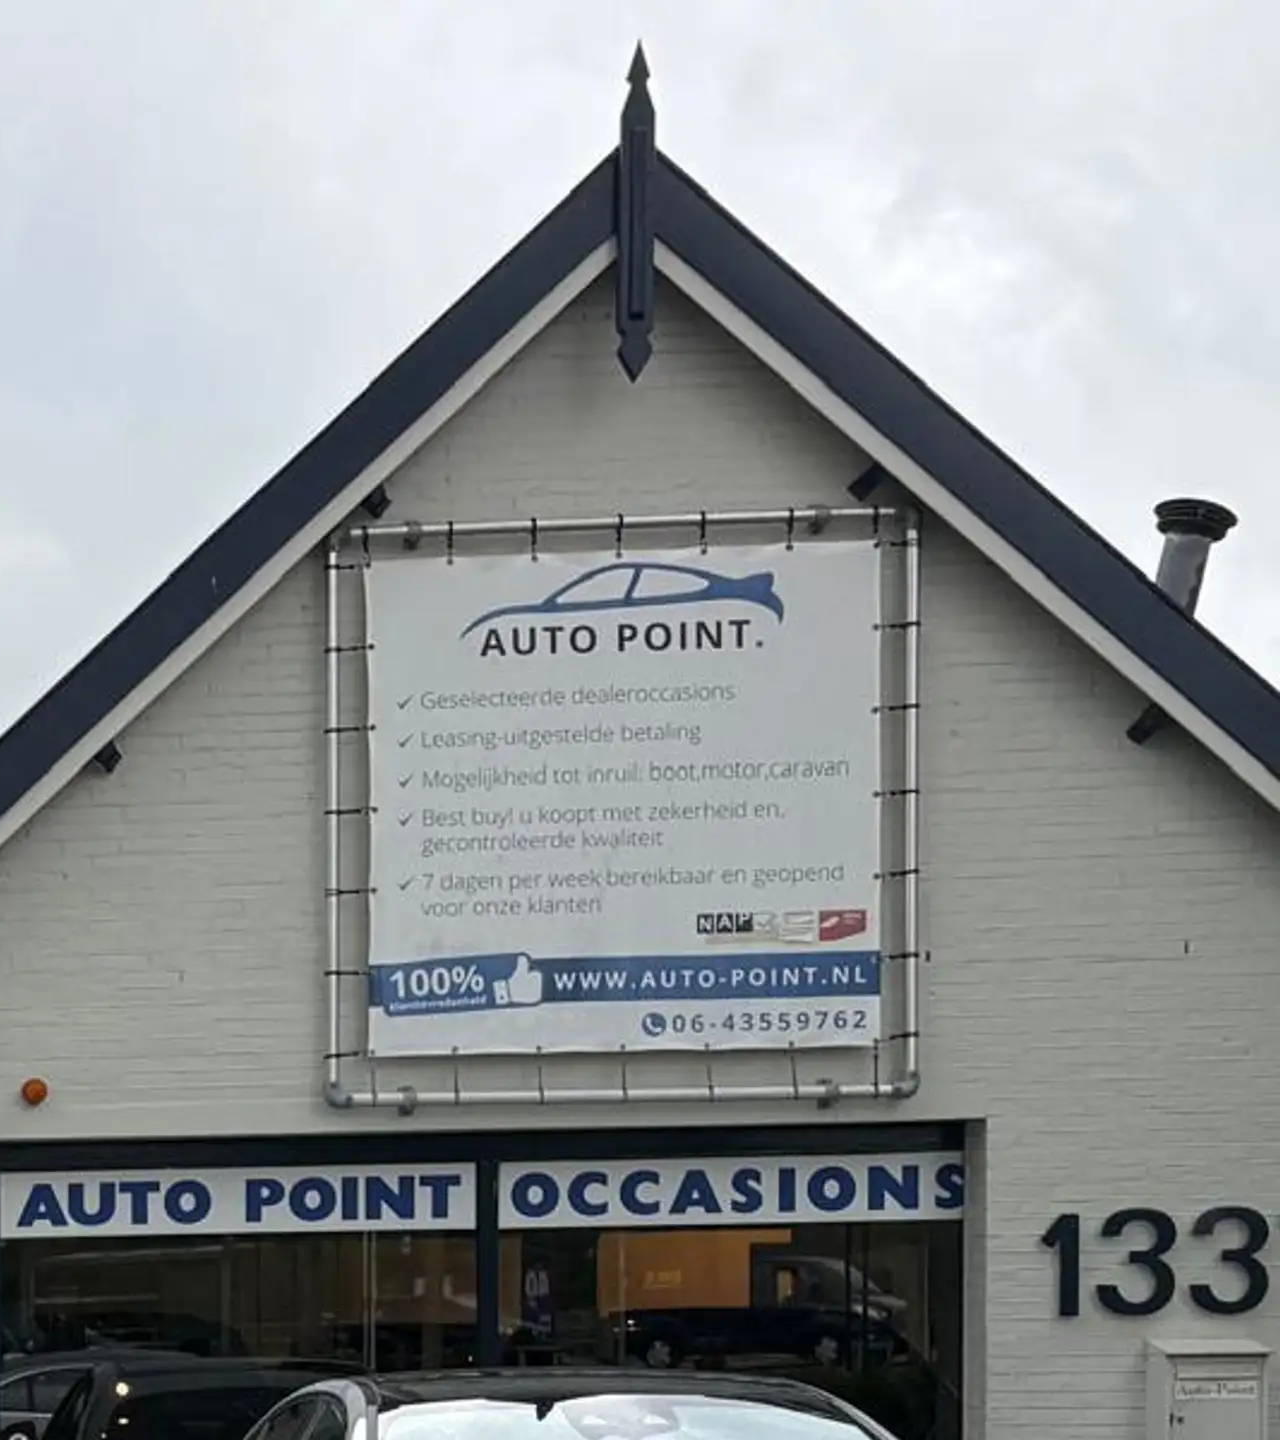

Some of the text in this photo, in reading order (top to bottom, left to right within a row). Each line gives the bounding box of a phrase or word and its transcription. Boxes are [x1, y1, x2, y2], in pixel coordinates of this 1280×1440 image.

[480, 624, 597, 656] AUTO
[420, 683, 736, 709] Geselecteerde dealeroccasions
[421, 722, 702, 750] Leasing-uitgestelde betaling
[422, 760, 547, 793] Mogelijkheid
[552, 768, 580, 785] tot
[421, 808, 466, 828] Best
[519, 810, 533, 825] u
[539, 805, 595, 829] koopt
[602, 805, 641, 823] met
[647, 801, 748, 821] zekerheid
[421, 828, 664, 857] gecontroleerde kwaliteit
[421, 864, 844, 894] 7 dagen per week bereikbaar en geopend
[421, 896, 602, 917] voor onze klanten
[389, 965, 485, 999] 100%
[554, 965, 867, 990] WWW.AUTO-POINT.NL
[672, 1010, 867, 1033] 06-43559762
[17, 1174, 462, 1228] AUTO POINT
[510, 1163, 964, 1217] OCCASIONS
[1041, 1205, 1269, 1316] 133
